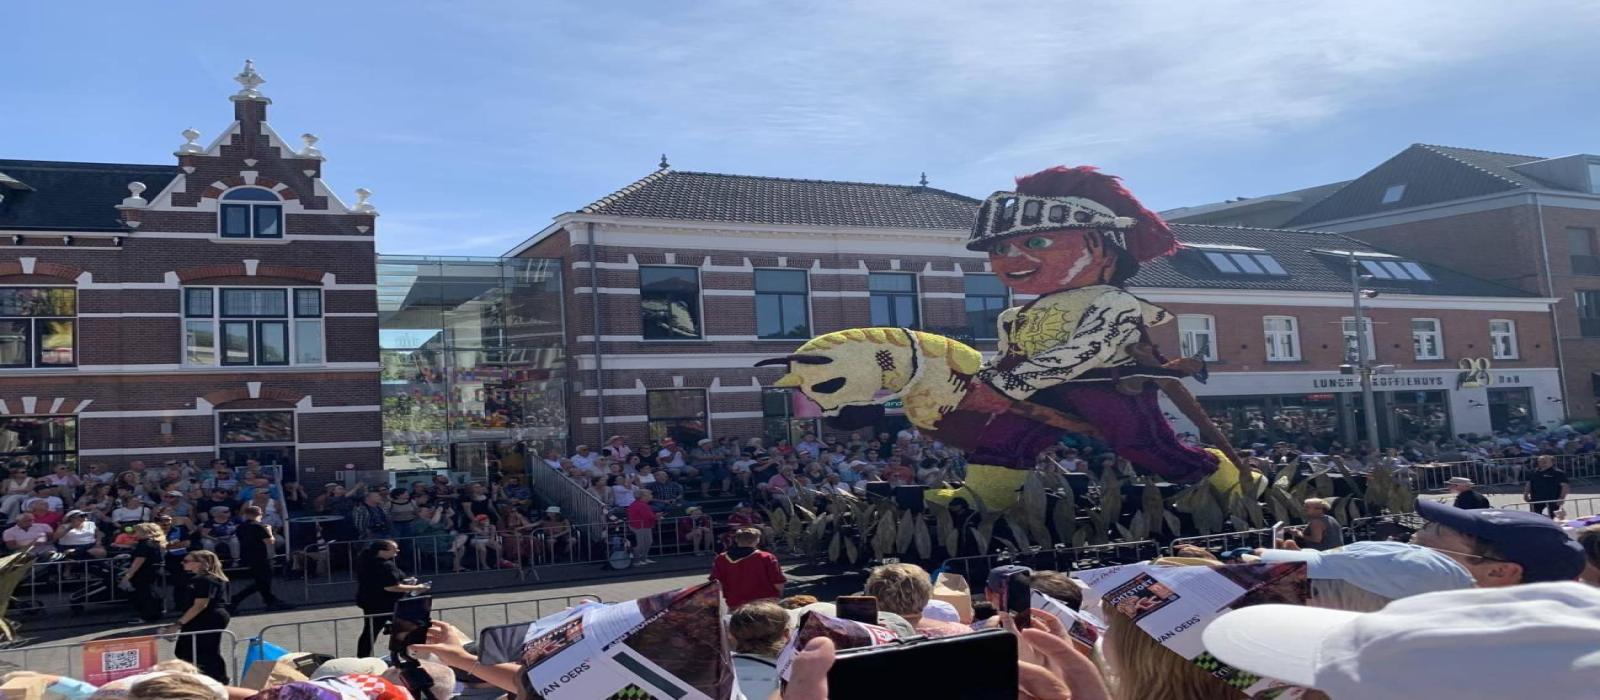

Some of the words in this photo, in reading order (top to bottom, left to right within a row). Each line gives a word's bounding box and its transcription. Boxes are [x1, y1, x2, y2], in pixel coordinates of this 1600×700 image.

[1313, 379, 1354, 388] LUNCH
[1174, 616, 1201, 633] OERS
[560, 662, 590, 683] OERS
